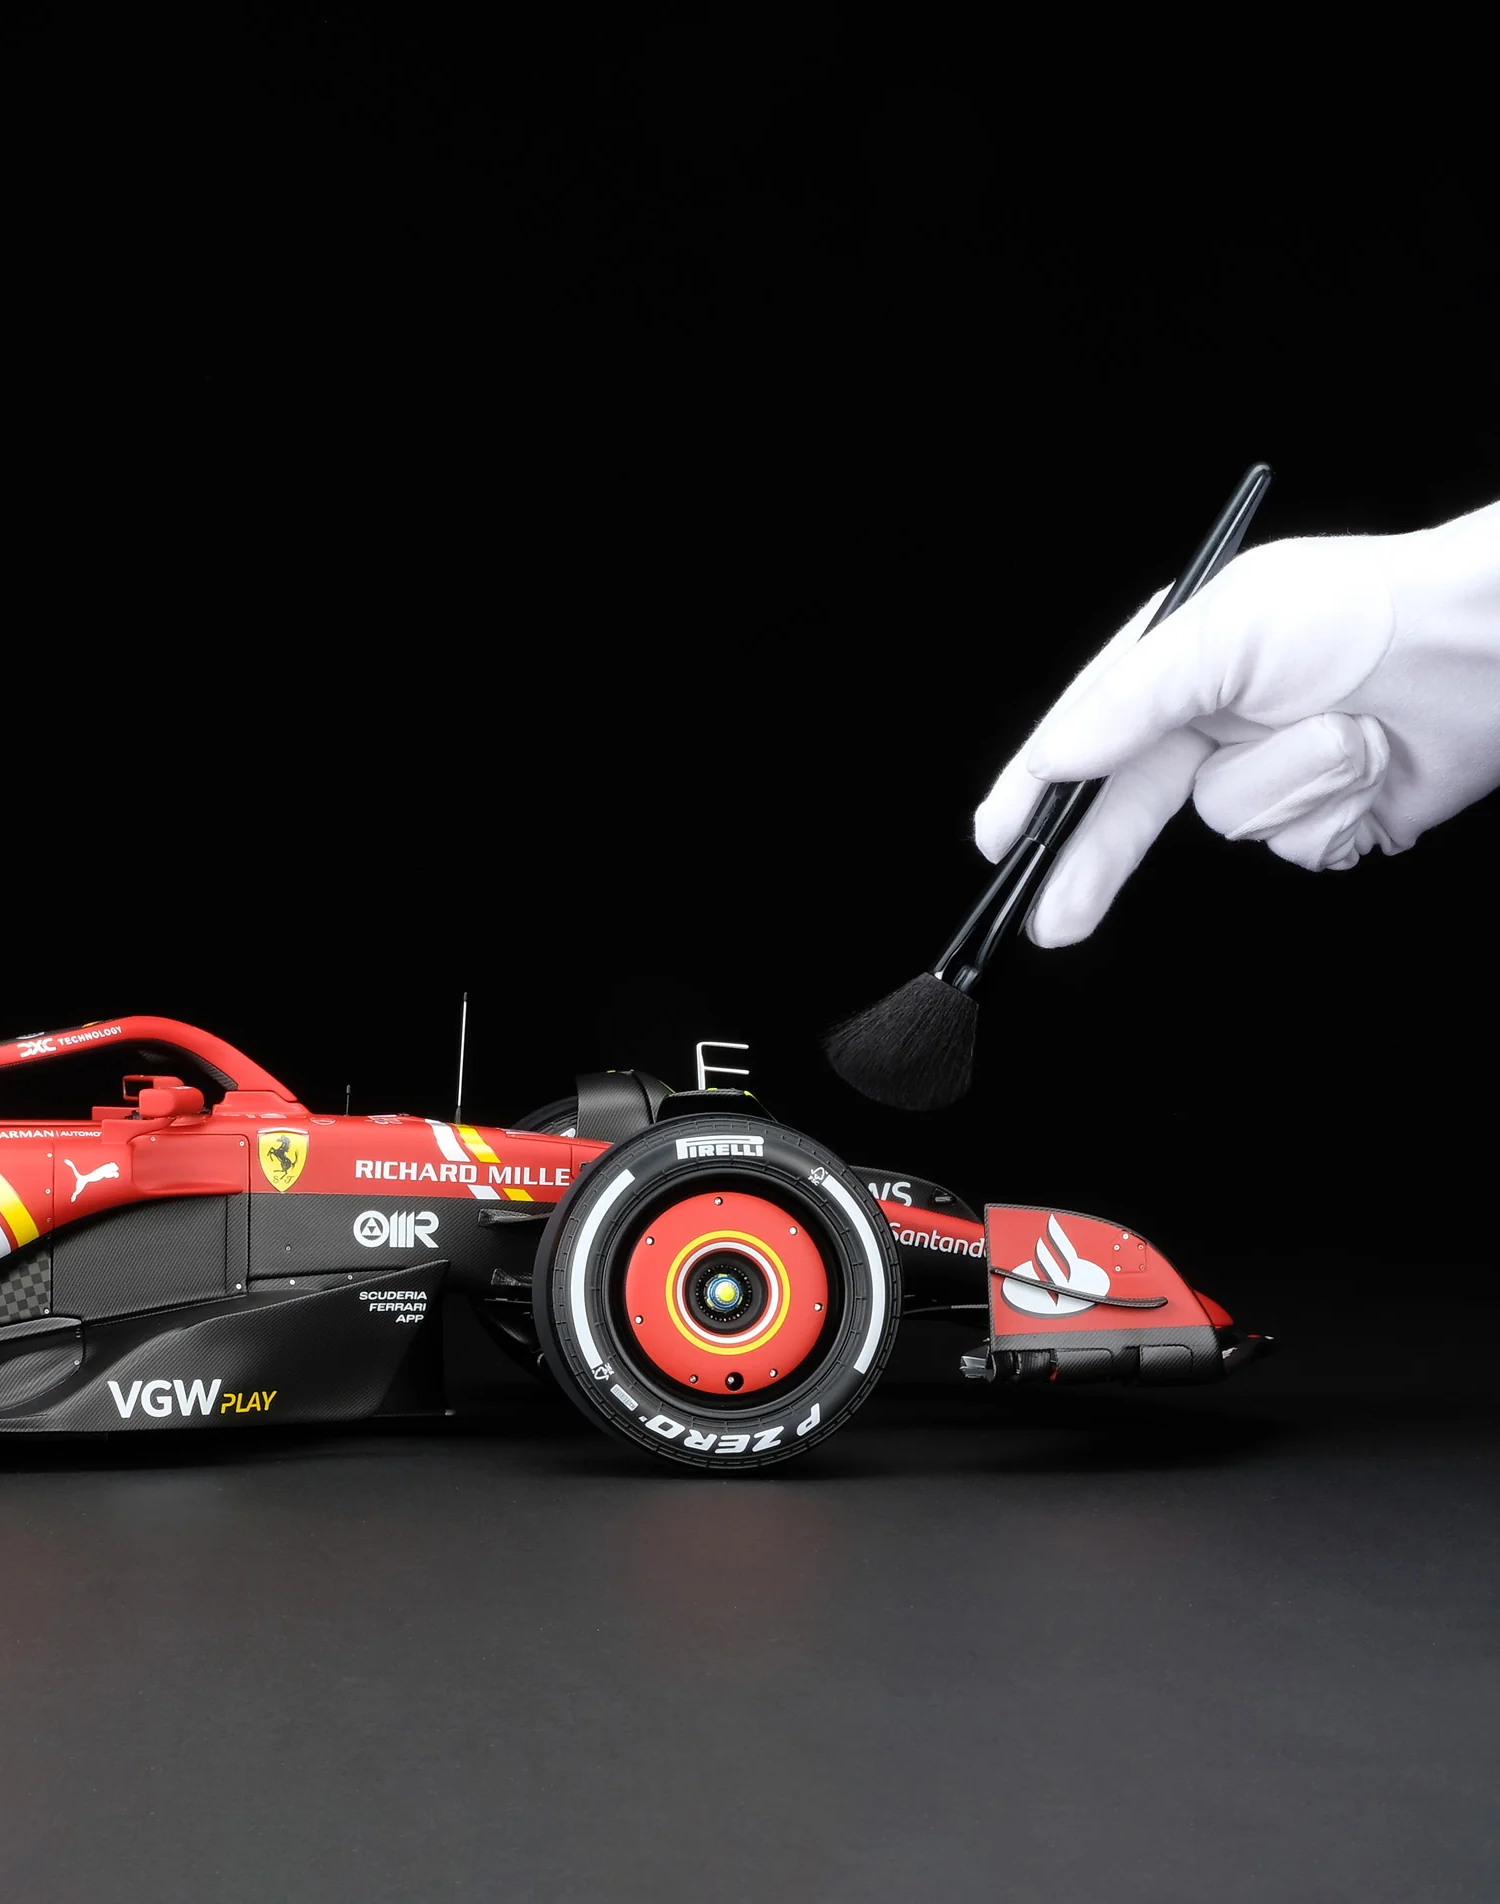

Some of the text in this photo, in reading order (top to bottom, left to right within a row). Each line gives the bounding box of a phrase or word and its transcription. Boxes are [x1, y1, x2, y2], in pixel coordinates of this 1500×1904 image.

[57, 1025, 122, 1046] TECHNOLOGY
[675, 1135, 764, 1160] PIRELLI
[355, 1159, 571, 1187] RICHARD MILLE
[889, 1222, 987, 1258] Santand
[359, 1291, 428, 1301] SCUDERIA
[369, 1302, 427, 1312] FERRARI
[395, 1314, 425, 1324] APP
[107, 1379, 278, 1419] VGW PLAY
[796, 1403, 821, 1437] P
